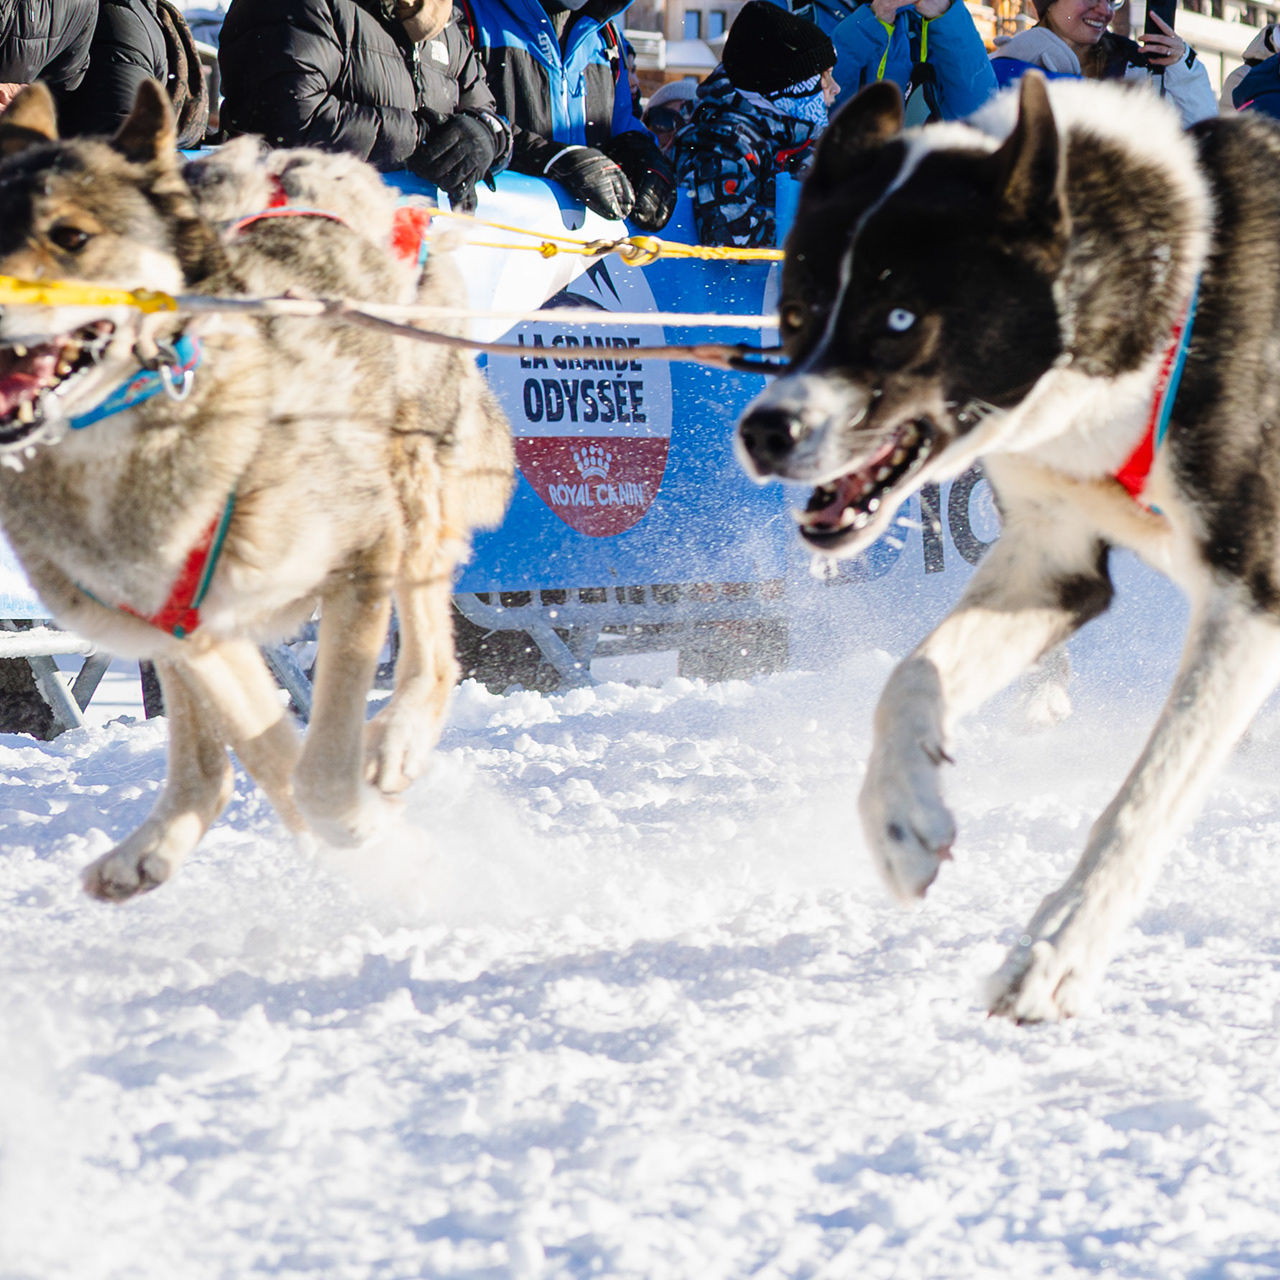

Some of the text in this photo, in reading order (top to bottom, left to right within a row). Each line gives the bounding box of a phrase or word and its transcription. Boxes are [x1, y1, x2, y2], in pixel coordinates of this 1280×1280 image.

[518, 334, 642, 371] LA GRANDE
[523, 373, 646, 423] ODYSSÉE
[549, 482, 644, 507] ROYAL CANIN
